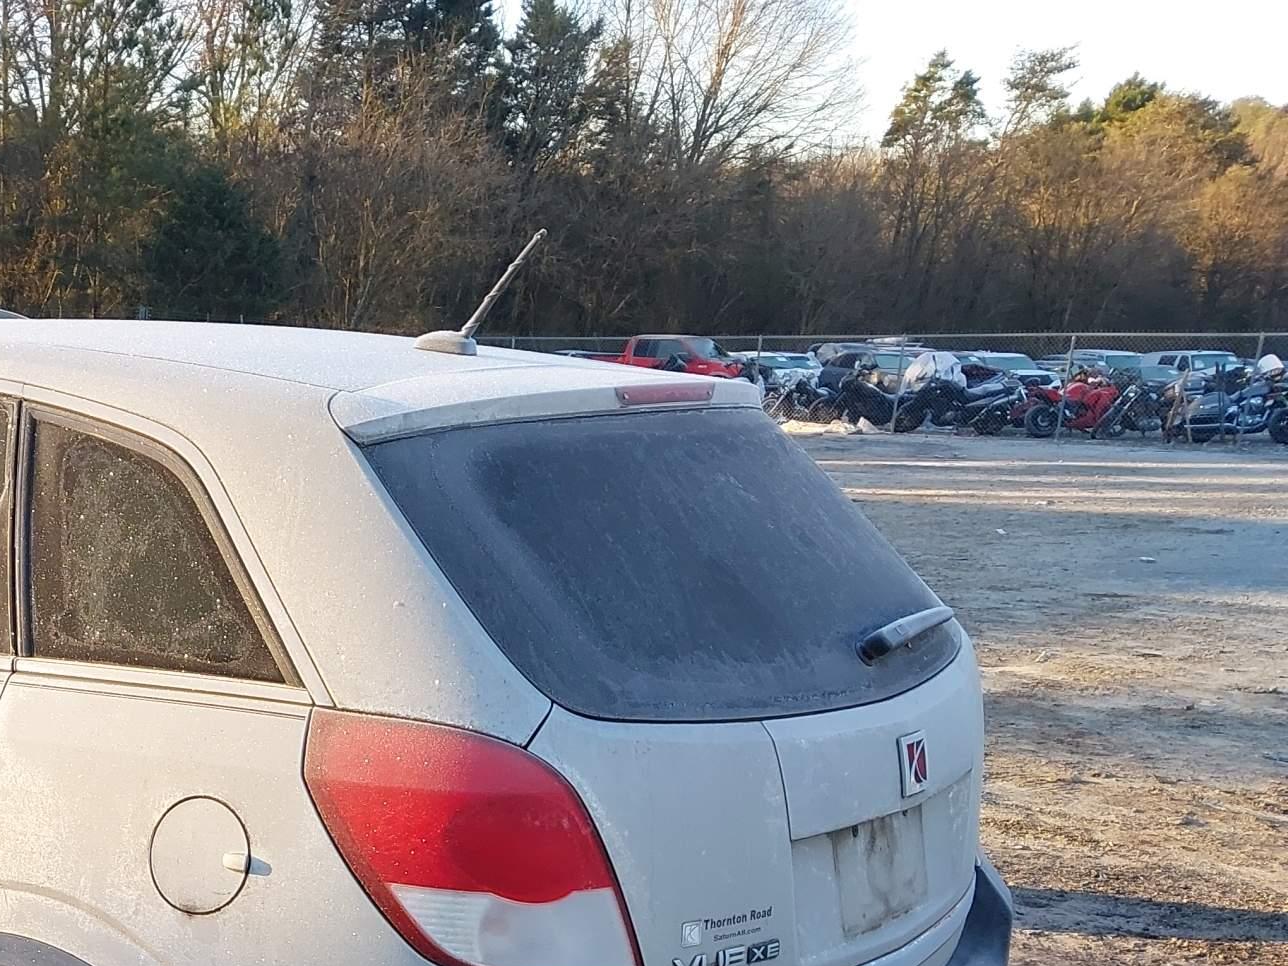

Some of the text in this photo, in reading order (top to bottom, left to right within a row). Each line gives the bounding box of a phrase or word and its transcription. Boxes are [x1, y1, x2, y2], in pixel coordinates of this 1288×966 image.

[704, 905, 772, 930] Thornton Road
[751, 941, 780, 963] XE
